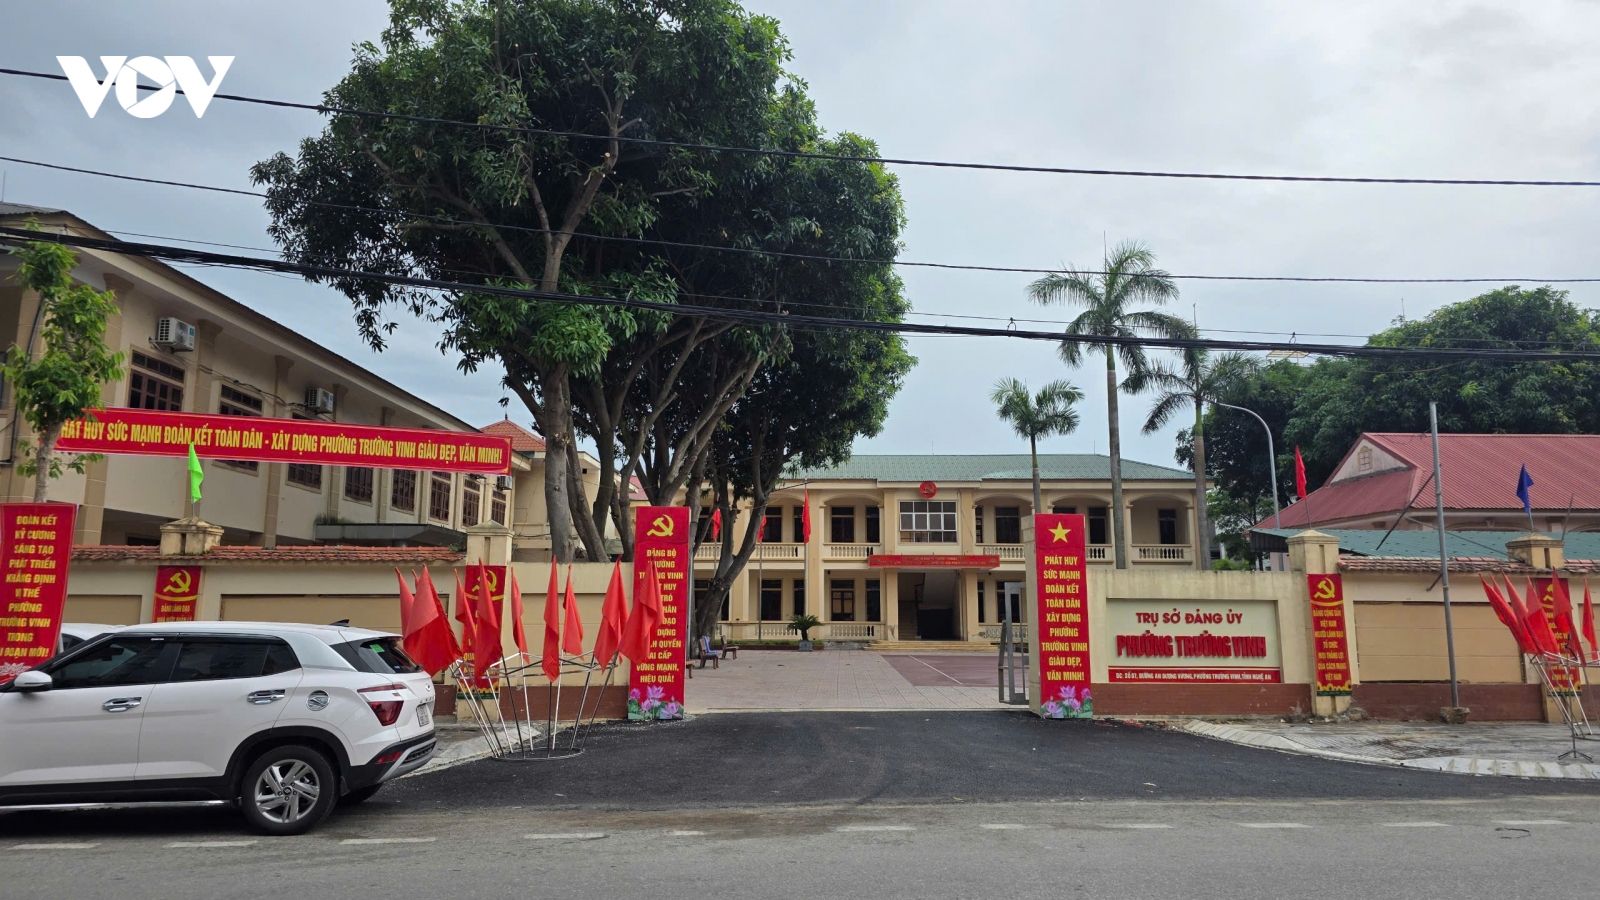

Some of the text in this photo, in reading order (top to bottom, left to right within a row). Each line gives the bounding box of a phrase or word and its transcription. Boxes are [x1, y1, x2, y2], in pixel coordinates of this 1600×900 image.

[61, 420, 82, 439] HÁT
[83, 421, 105, 440] HUY
[106, 419, 128, 442] SỨC
[130, 424, 162, 447] MẠNH
[164, 423, 191, 445] ĐOÀN
[194, 422, 213, 447] KẾT
[215, 426, 240, 448] TOÀN
[242, 430, 263, 449] DÂN
[271, 430, 290, 450] XÂY
[291, 433, 317, 455] DỰNG
[320, 435, 357, 456] PHƯỜNG
[359, 435, 394, 457] TRƯỜNG
[396, 441, 416, 459] VINH
[418, 442, 438, 460] GIÀU
[439, 444, 457, 465] ĐẸP,
[459, 443, 477, 463] VĂN
[477, 448, 503, 465] MINH!
[16, 514, 58, 525] ĐOÀN KẾT
[15, 528, 56, 540] KỶ CƯƠNG
[14, 543, 54, 556] SÁNG TẠO
[646, 547, 677, 558] ĐẢNG BỘ
[9, 556, 56, 569] PHÁT TRIỂN
[1044, 555, 1078, 566] PHÁT HUY
[33, 573, 56, 585] ĐỊNH
[667, 571, 684, 580] VINH
[1043, 569, 1081, 582] SỨC MẠNH
[23, 586, 41, 598] THẾ
[663, 583, 677, 591] HUY
[1045, 583, 1080, 595] ĐOÀN KẾT
[8, 601, 43, 613] PHƯỜNG
[1045, 598, 1081, 609] TOÀN DÂN
[29, 618, 51, 628] VINH
[662, 617, 677, 626] ĐẠO
[1046, 612, 1081, 625] XÂY DỰNG
[1135, 608, 1244, 628] TRỤ SỞ ĐẢNG ỦY
[7, 632, 34, 642] TRONG
[657, 628, 677, 638] DỰNG
[1049, 626, 1079, 637] PHƯỜNG
[1041, 640, 1088, 652] TRƯỜNG VINH
[1116, 630, 1267, 658] PHƯỜNG TRƯỜNG VINH
[4, 647, 28, 659] ĐOẠN
[28, 645, 50, 658] MỚI!
[657, 649, 672, 660] CẤP
[636, 662, 680, 672] VỮNG MẠNH,
[1048, 656, 1082, 669] GIÀU ĐẸP,
[640, 672, 675, 685] HIỆU QUẢ!
[1046, 670, 1085, 681] VĂN MINH!
[1139, 671, 1154, 679] ĐƯỜNG
[1194, 672, 1211, 680] PHƯỜNG
[1212, 672, 1229, 680] TRƯỜNG
[1325, 673, 1333, 682] VIỆT
